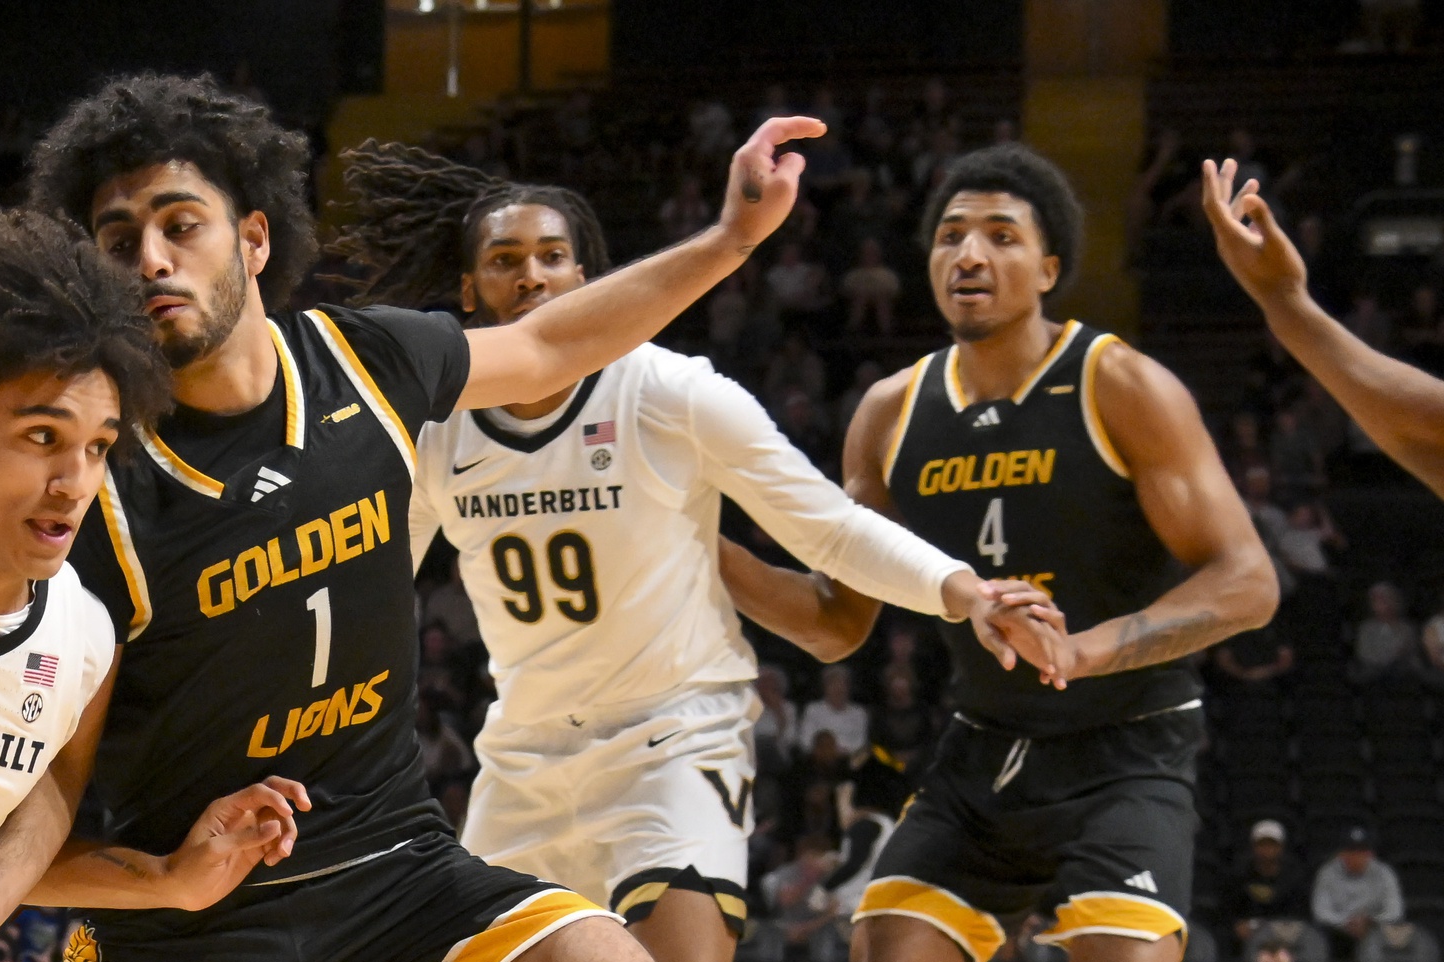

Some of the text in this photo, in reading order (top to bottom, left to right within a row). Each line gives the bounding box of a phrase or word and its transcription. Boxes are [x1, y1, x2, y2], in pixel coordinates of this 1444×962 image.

[454, 485, 623, 518] VANDERBILT
[917, 449, 1056, 496] GOLDEN
[197, 490, 390, 618] GOLDEN
[976, 498, 1008, 566] 4
[490, 528, 601, 625] 99
[307, 587, 332, 688] 1
[246, 670, 389, 758] LIONS
